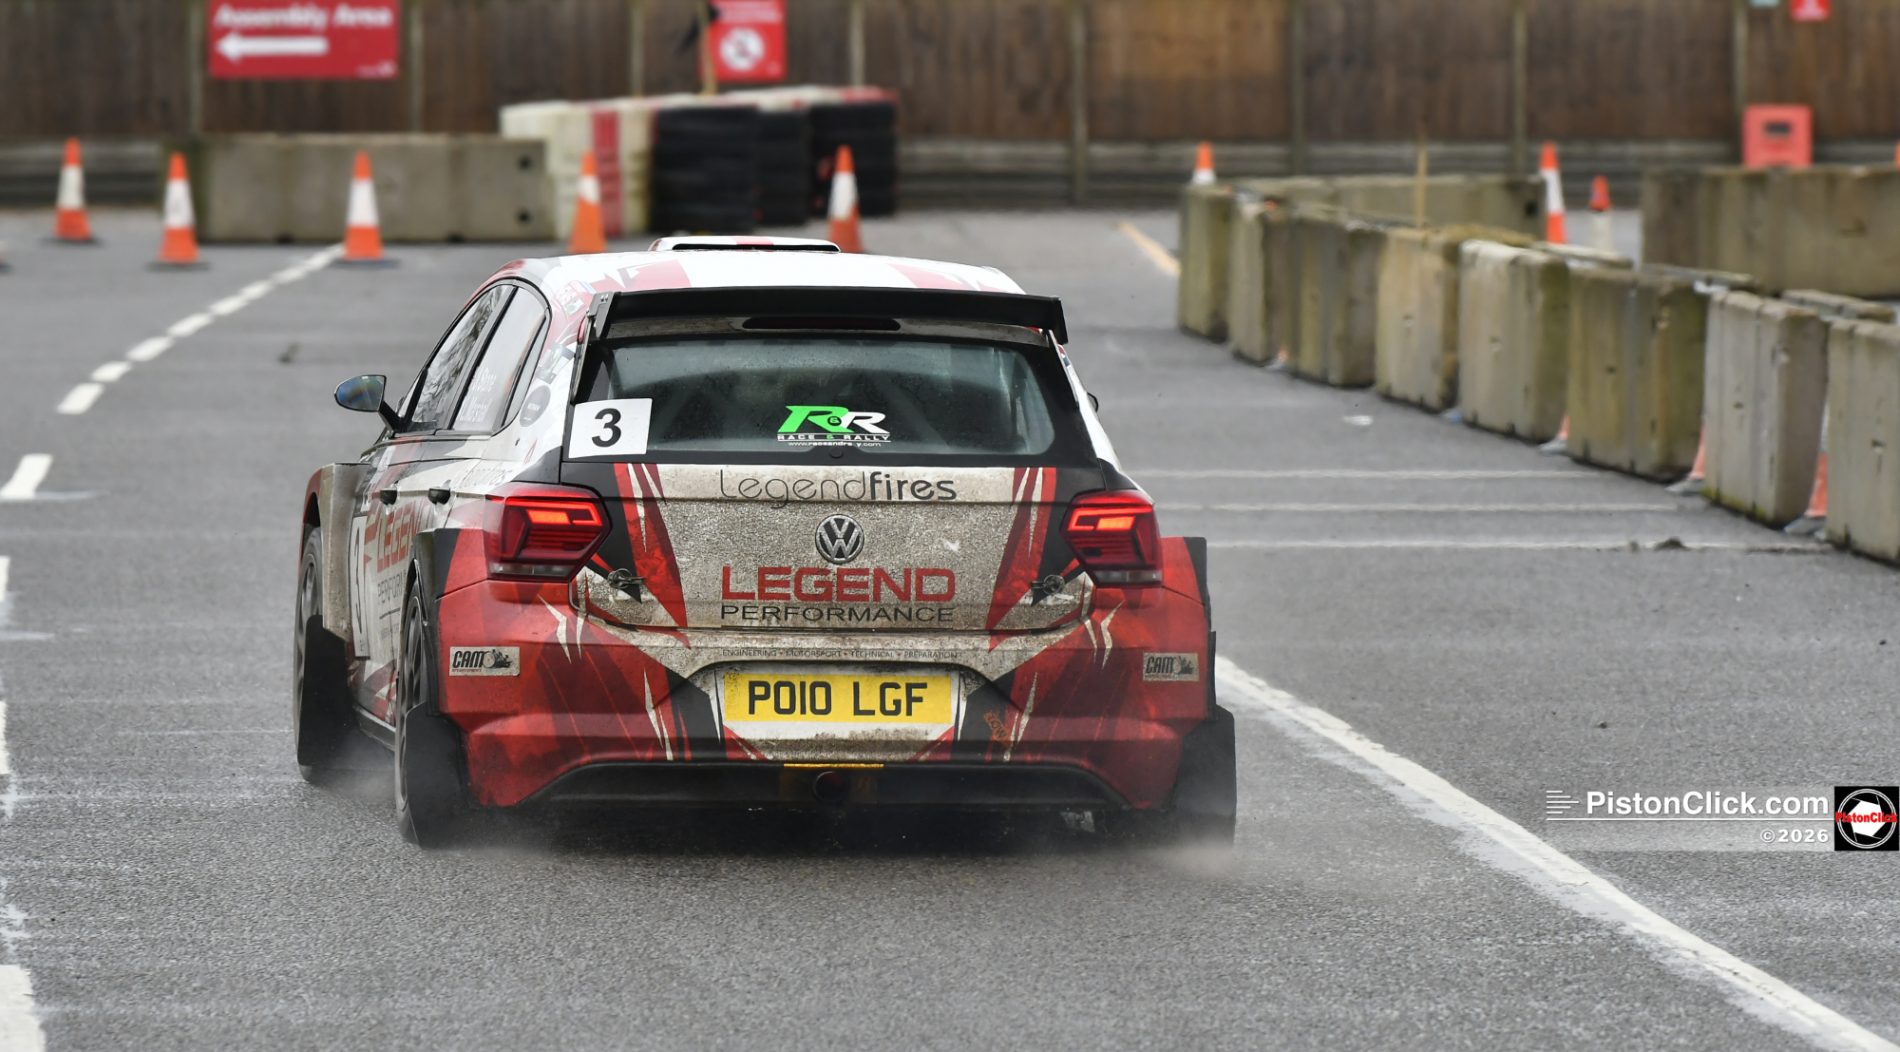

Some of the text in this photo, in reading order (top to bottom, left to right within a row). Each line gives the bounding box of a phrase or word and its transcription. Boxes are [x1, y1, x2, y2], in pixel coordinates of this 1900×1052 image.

[334, 3, 393, 27] Area
[592, 408, 622, 447] 3
[816, 514, 864, 564] VW
[722, 566, 956, 602] LEGEND
[721, 605, 953, 622] PERFORMANCE
[452, 651, 484, 668] CAM
[786, 650, 841, 658] MOTORSPORT
[1145, 656, 1174, 673] CAM
[853, 682, 928, 717] LGF
